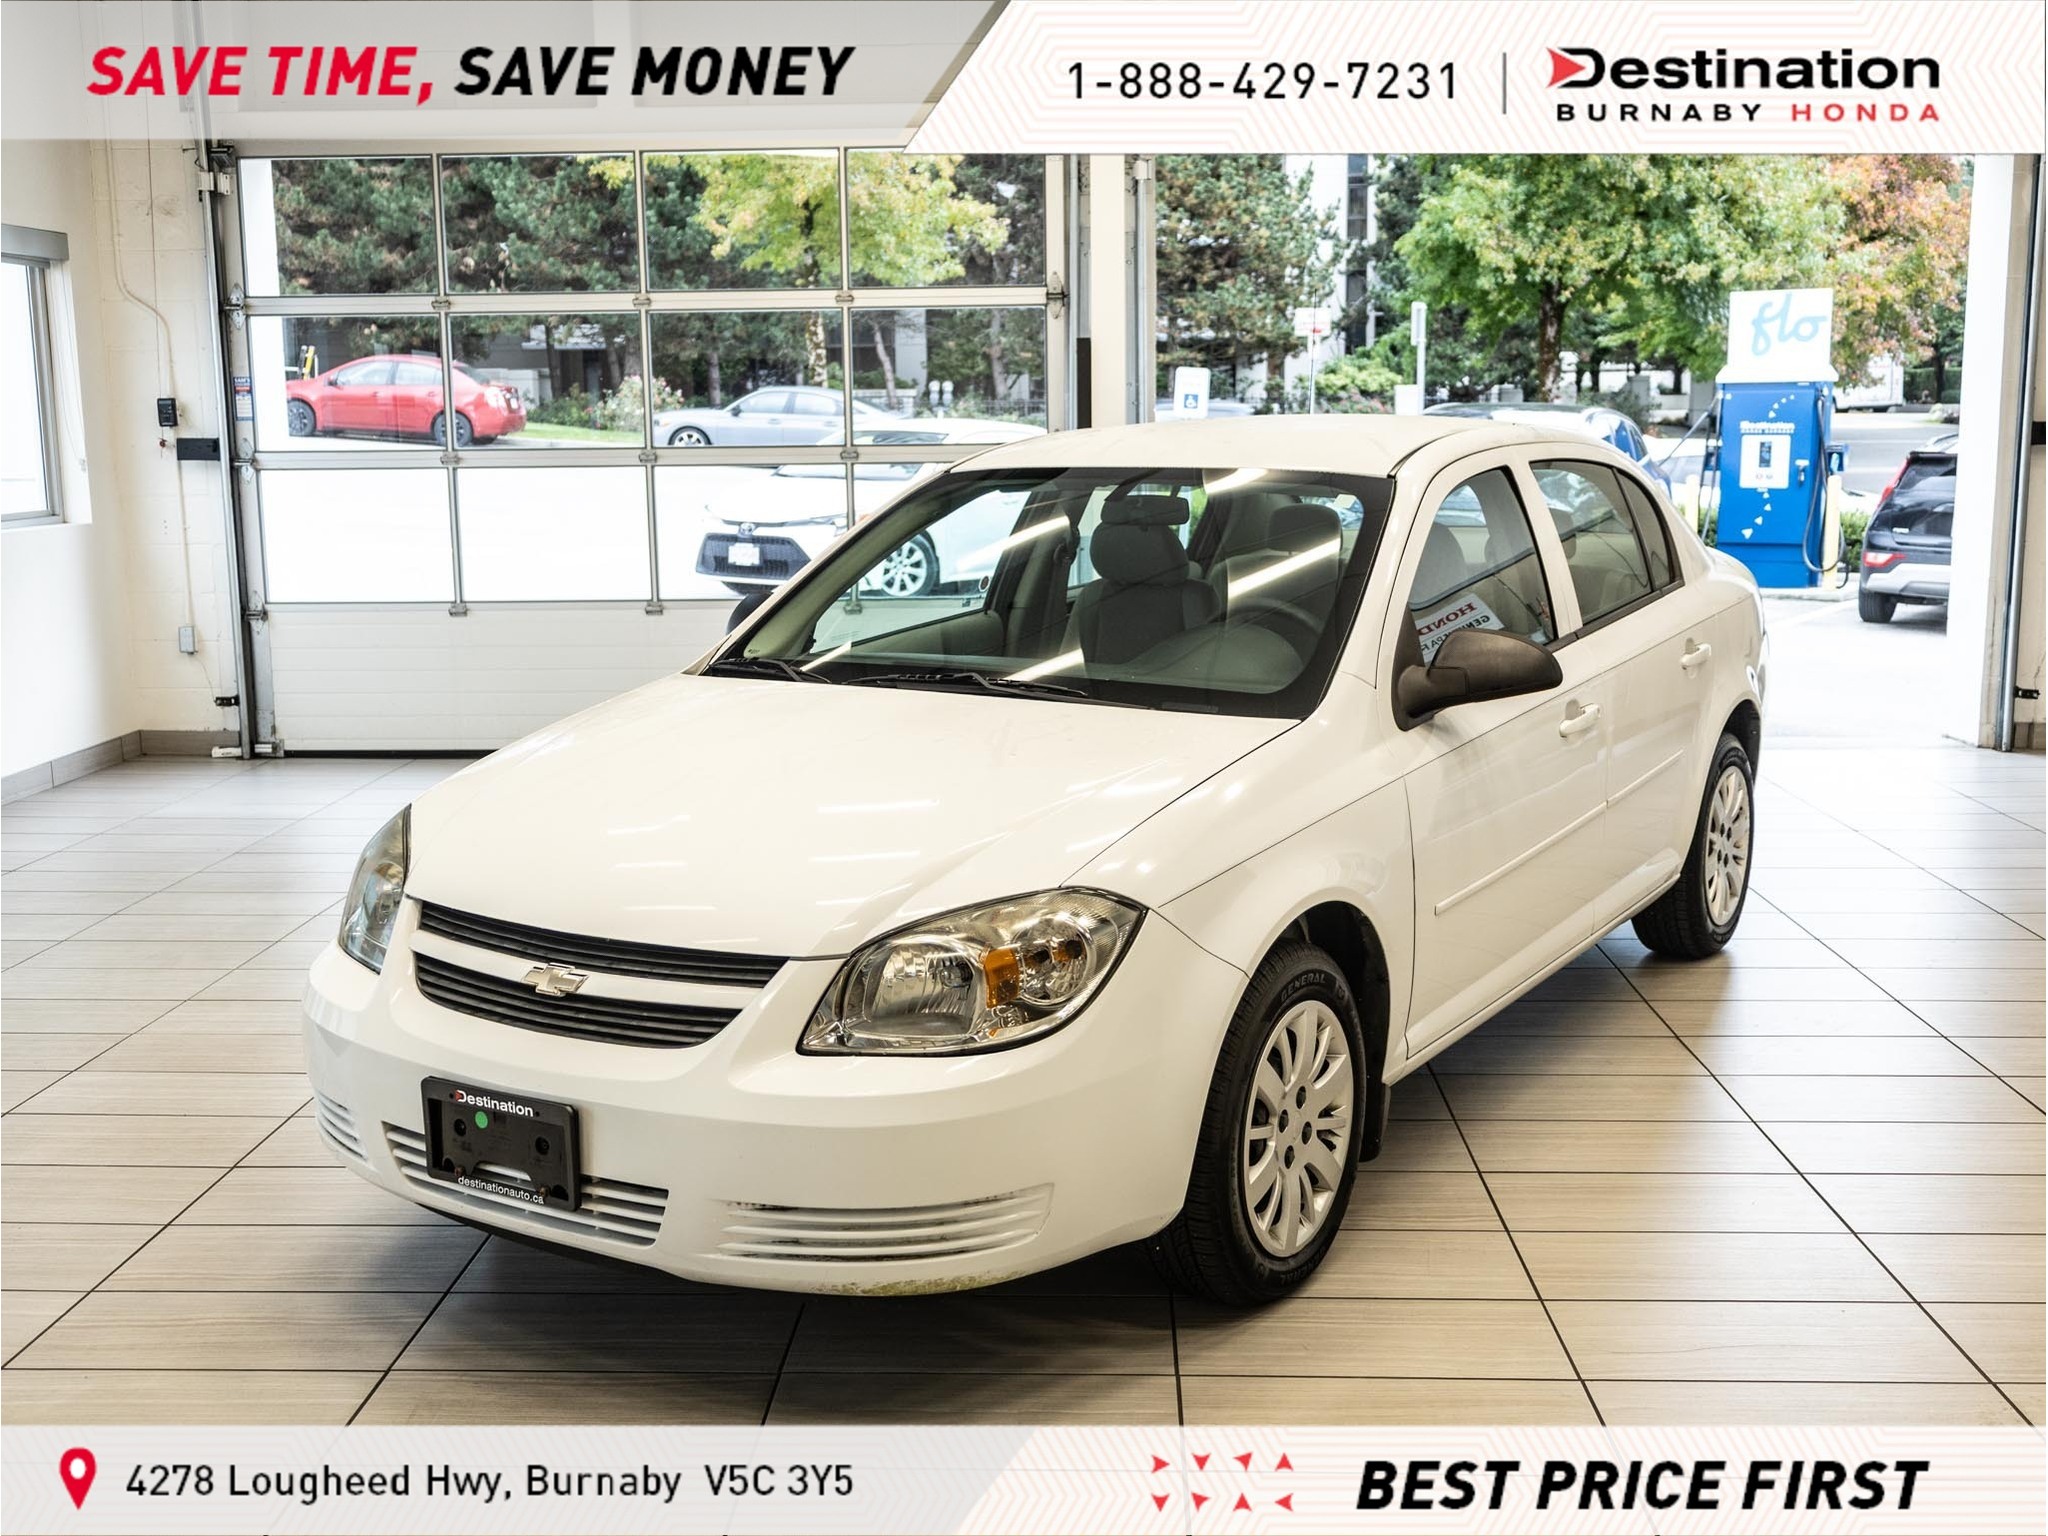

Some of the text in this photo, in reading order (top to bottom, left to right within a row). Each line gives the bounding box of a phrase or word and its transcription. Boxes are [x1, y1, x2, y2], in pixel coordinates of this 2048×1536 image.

[1752, 293, 1828, 355] flo
[1280, 972, 1326, 1000] GENERAL
[456, 1089, 533, 1117] Destination
[458, 1176, 544, 1204] destinationauto.ca
